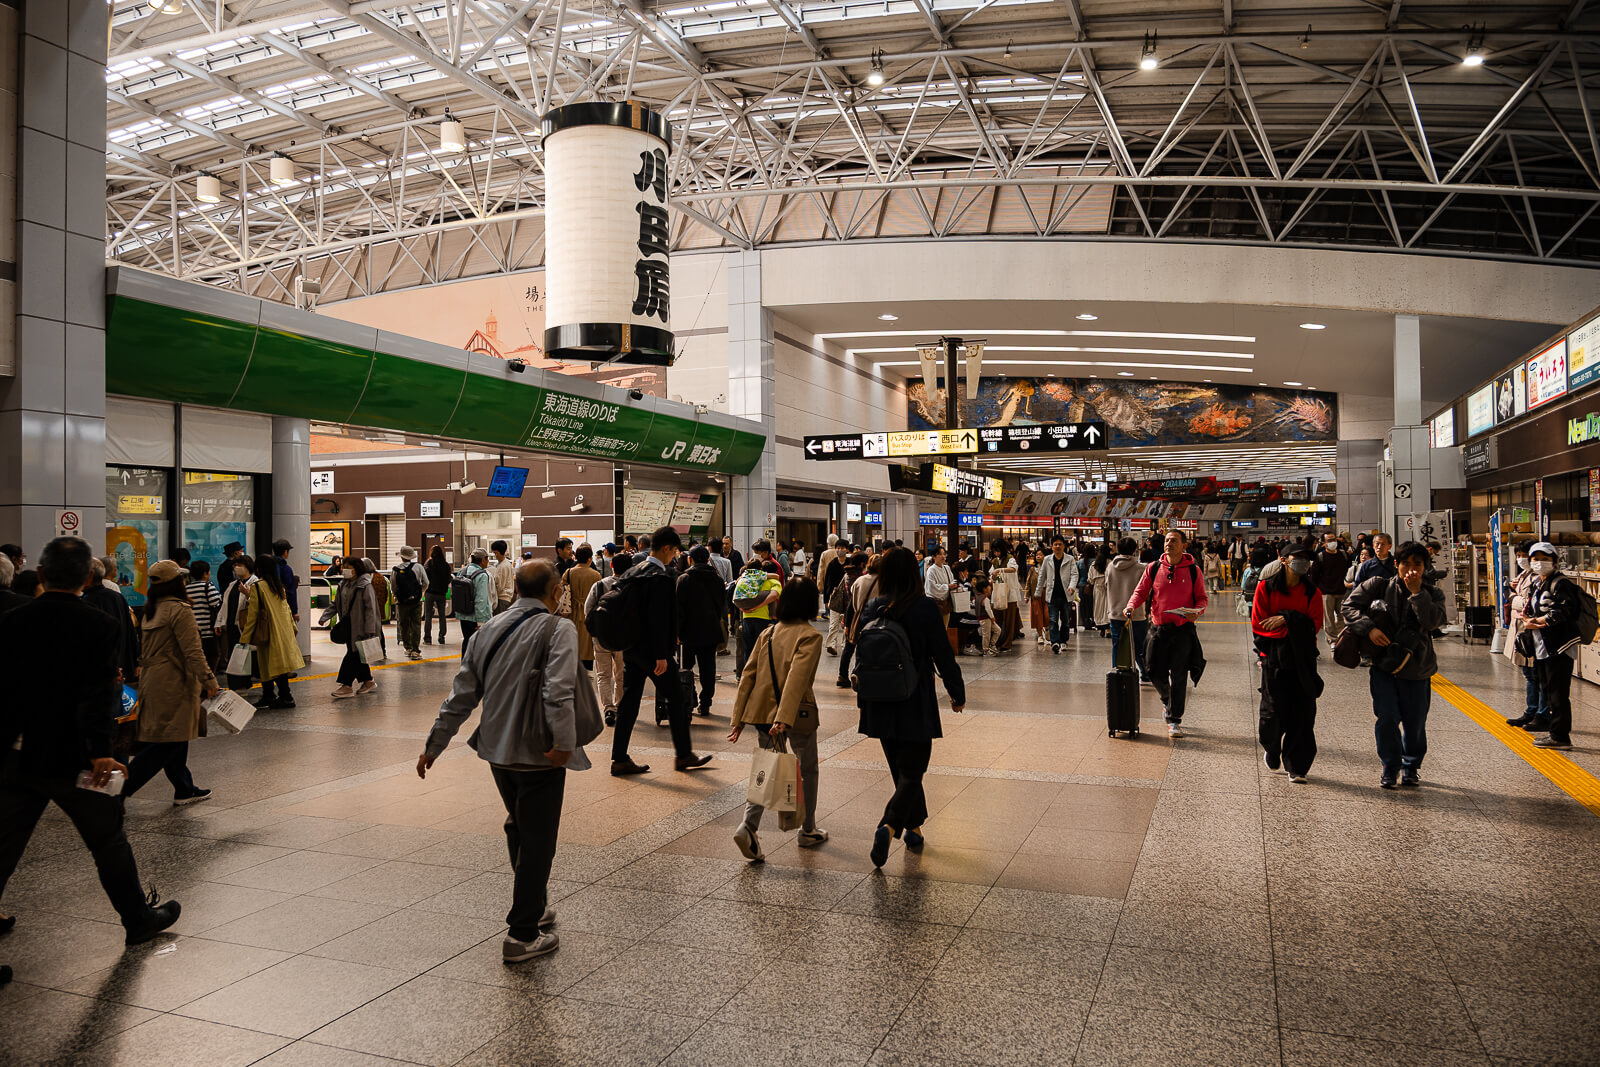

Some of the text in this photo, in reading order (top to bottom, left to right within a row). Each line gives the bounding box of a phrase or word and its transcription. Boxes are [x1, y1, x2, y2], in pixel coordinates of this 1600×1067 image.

[1539, 355, 1565, 384] ういろう
[542, 392, 619, 423] 東海道線のりば
[567, 417, 584, 430] Line
[1568, 413, 1600, 445] NewDa
[981, 429, 1003, 438] 新幹線
[1048, 426, 1077, 435] 小田急線
[890, 433, 926, 442] バスのりば
[941, 434, 960, 444] 西口
[834, 439, 861, 448] 東海道線
[661, 440, 687, 461] JR
[687, 444, 722, 466] 東日本
[1165, 479, 1197, 488] ODAWARA
